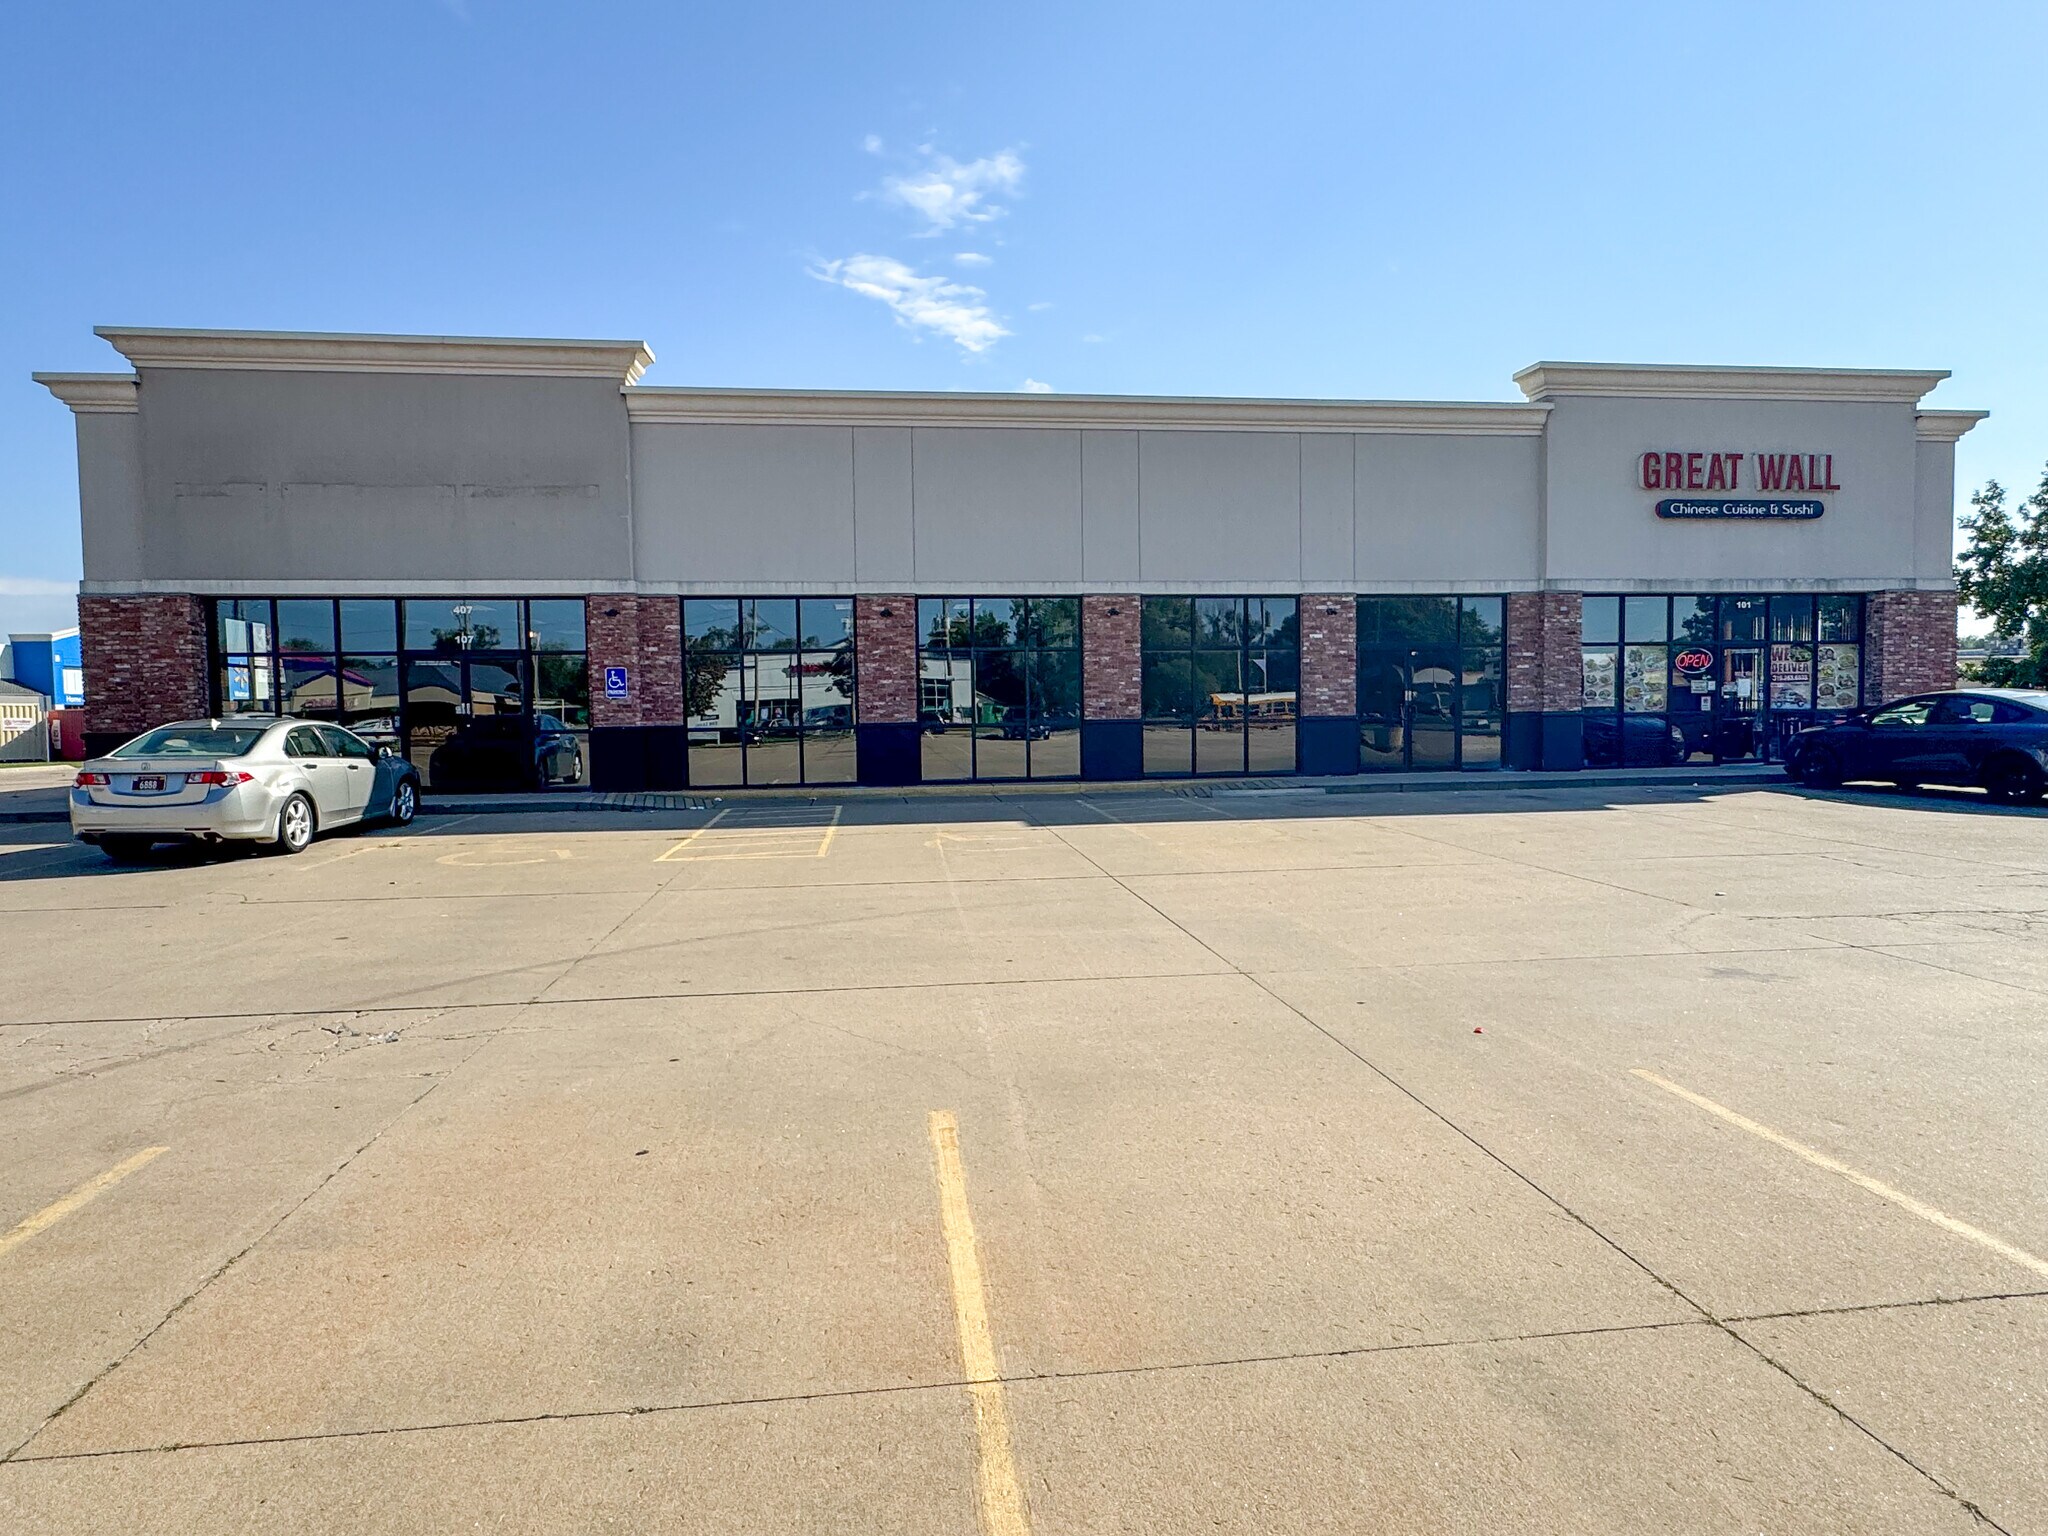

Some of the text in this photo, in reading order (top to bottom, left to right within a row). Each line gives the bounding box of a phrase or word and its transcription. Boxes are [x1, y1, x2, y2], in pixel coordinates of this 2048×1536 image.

[1642, 452, 1841, 491] GREAT WALL
[1670, 503, 1814, 515] Chinese Cuisine & Sushi
[453, 606, 473, 614] 407
[1736, 601, 1751, 609] 101
[455, 636, 474, 644] 107
[1771, 647, 1790, 661] WE
[1677, 654, 1710, 667] OPEN
[1771, 663, 1809, 673] DELIVER
